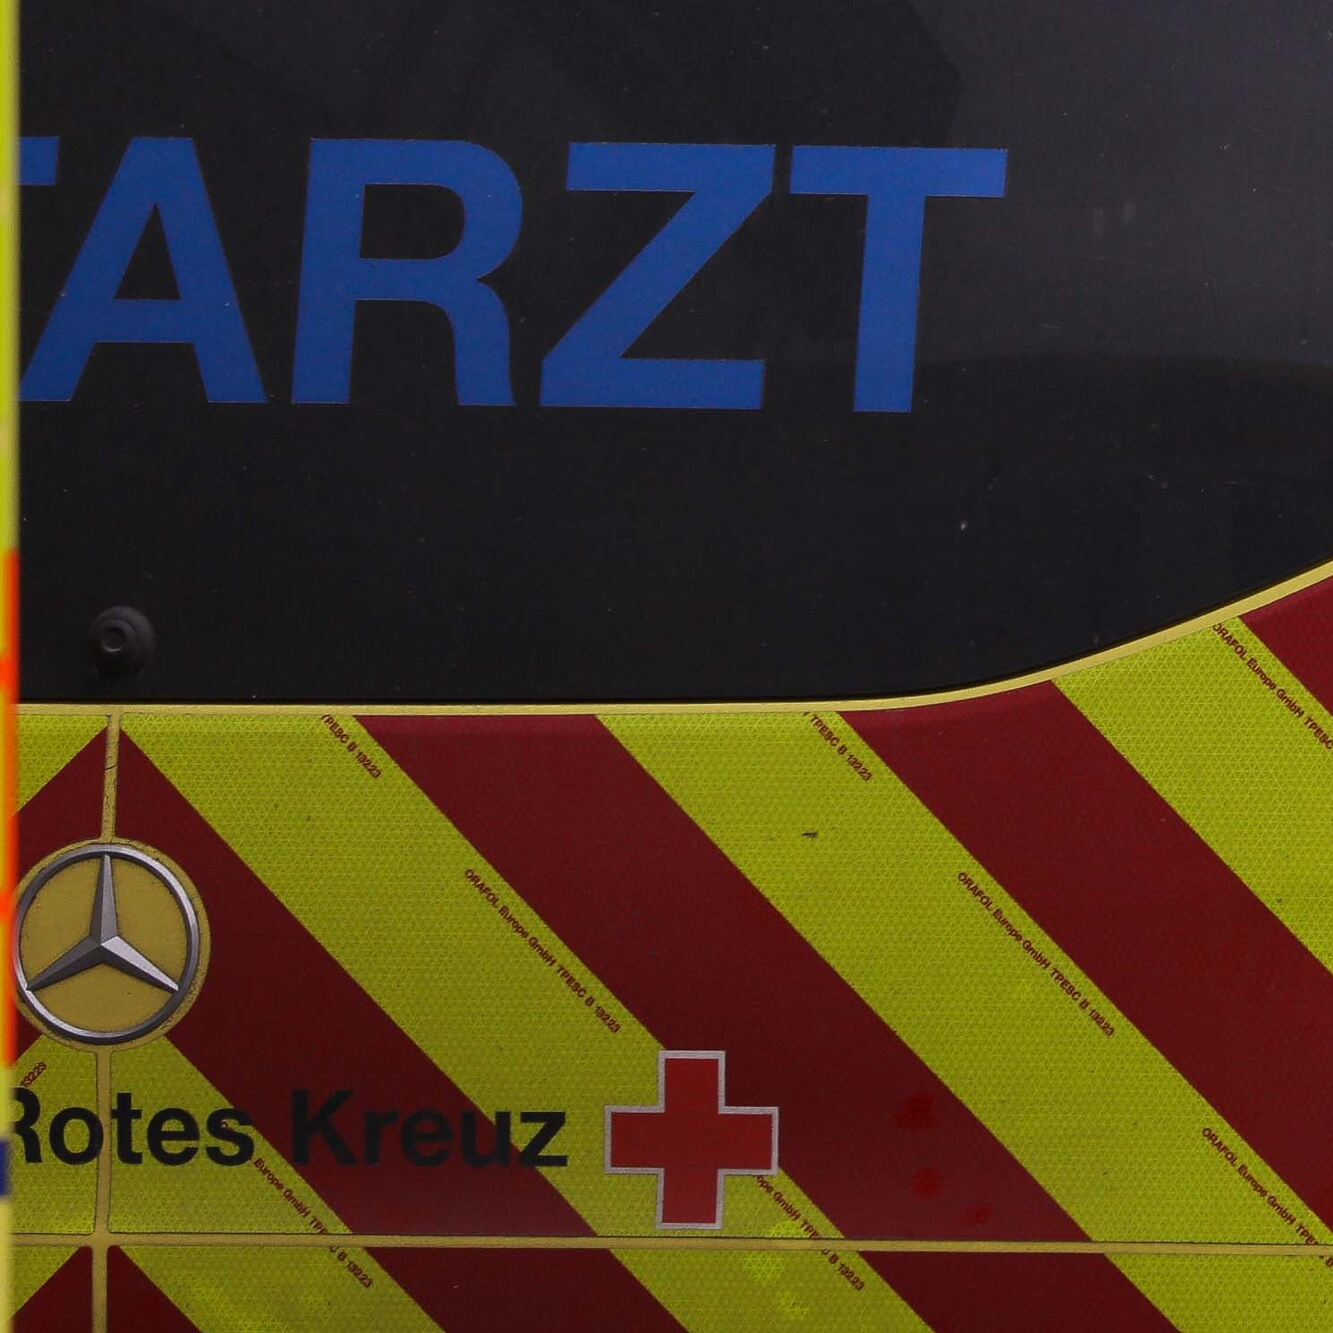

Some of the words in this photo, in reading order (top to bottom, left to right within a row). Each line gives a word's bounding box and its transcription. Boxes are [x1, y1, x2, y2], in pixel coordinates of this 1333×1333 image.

[18, 136, 1008, 413] ARZT
[1246, 657, 1277, 690] Europe
[1276, 688, 1305, 718] GmbH
[464, 868, 499, 908] ORAFOL
[498, 905, 530, 939] Europe
[528, 936, 558, 966] GmbH
[957, 872, 993, 911] ORAFOL
[992, 908, 1024, 942] Europe
[1022, 939, 1051, 970] GmbH
[253, 1157, 284, 1190] Europe
[291, 1088, 569, 1167] Kreuz
[1201, 1127, 1239, 1168] ORAFOL
[1237, 1164, 1268, 1198] Europe
[1267, 1195, 1297, 1226] GmbH
